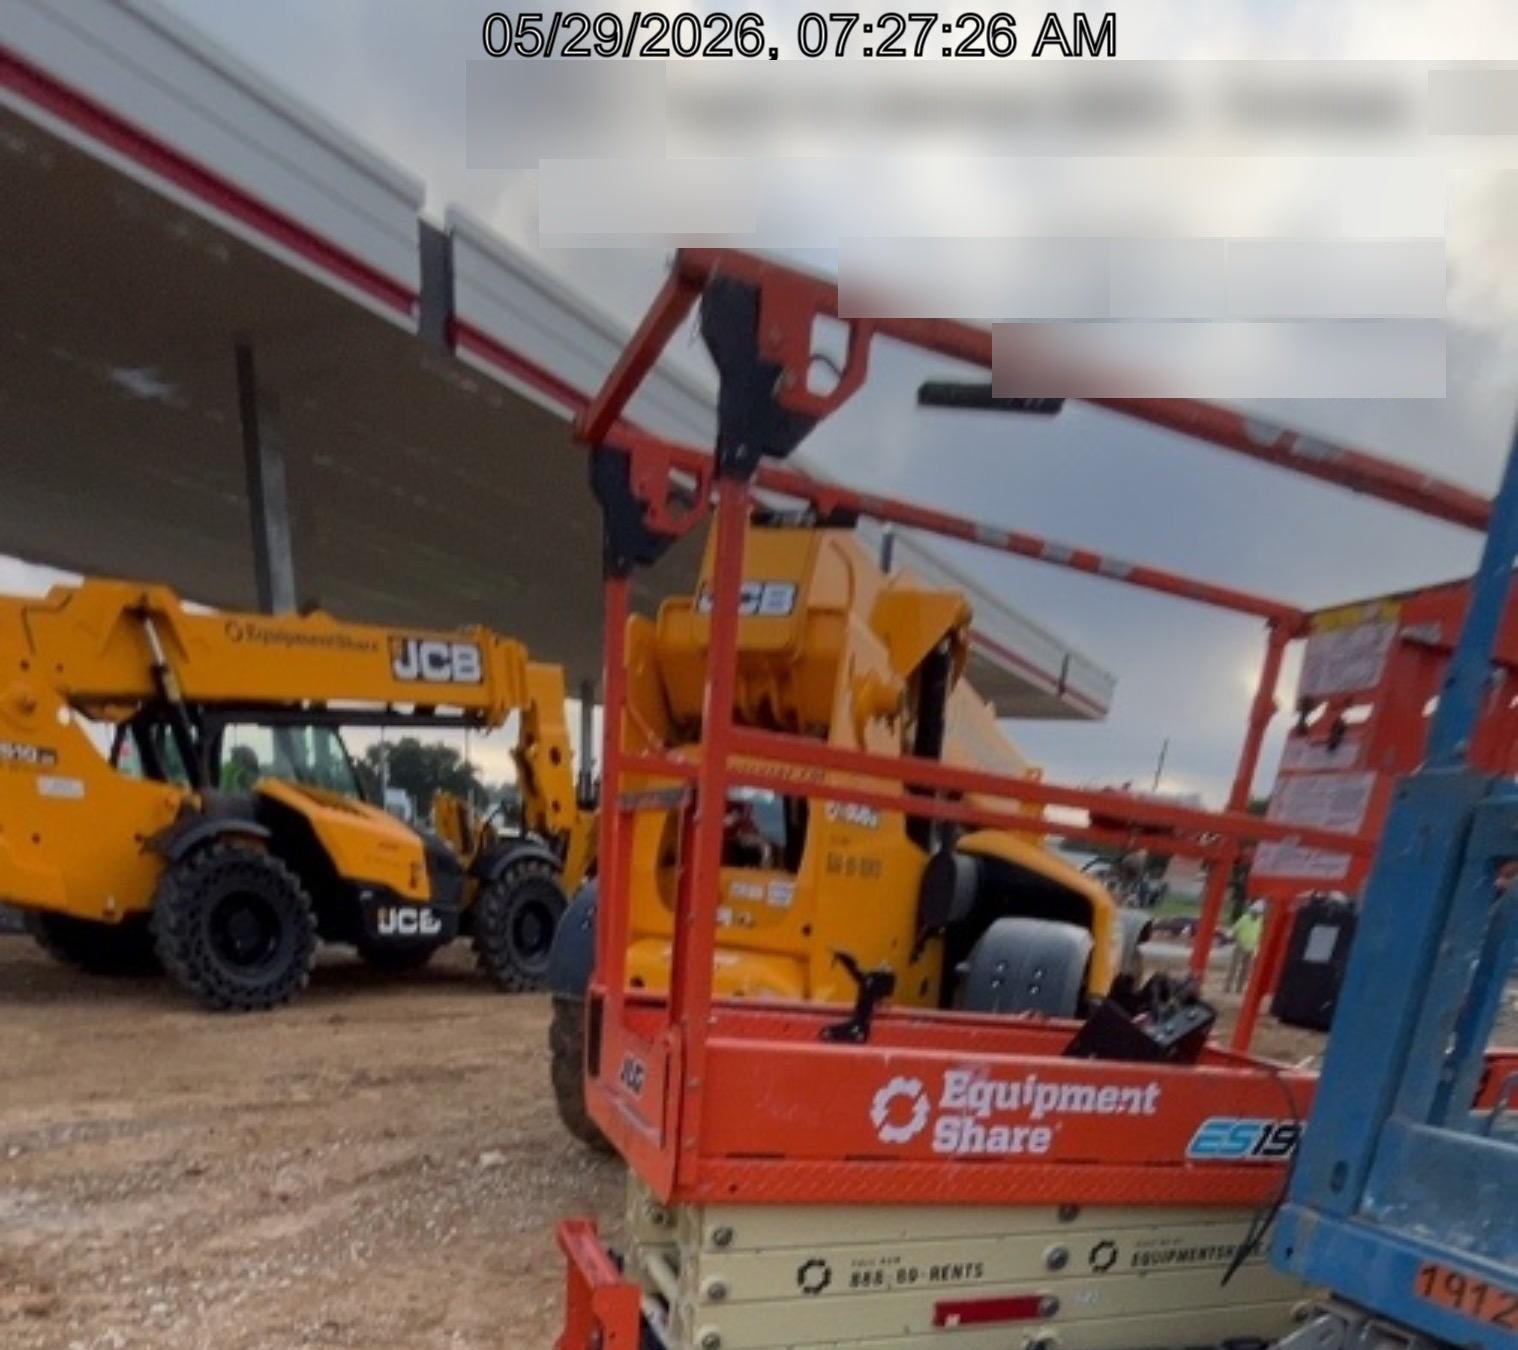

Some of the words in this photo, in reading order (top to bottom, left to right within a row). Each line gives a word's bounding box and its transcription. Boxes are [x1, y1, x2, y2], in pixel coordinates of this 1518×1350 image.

[393, 638, 483, 684] JCB
[939, 1070, 1160, 1121] Equipment
[931, 1114, 1054, 1154] Share
